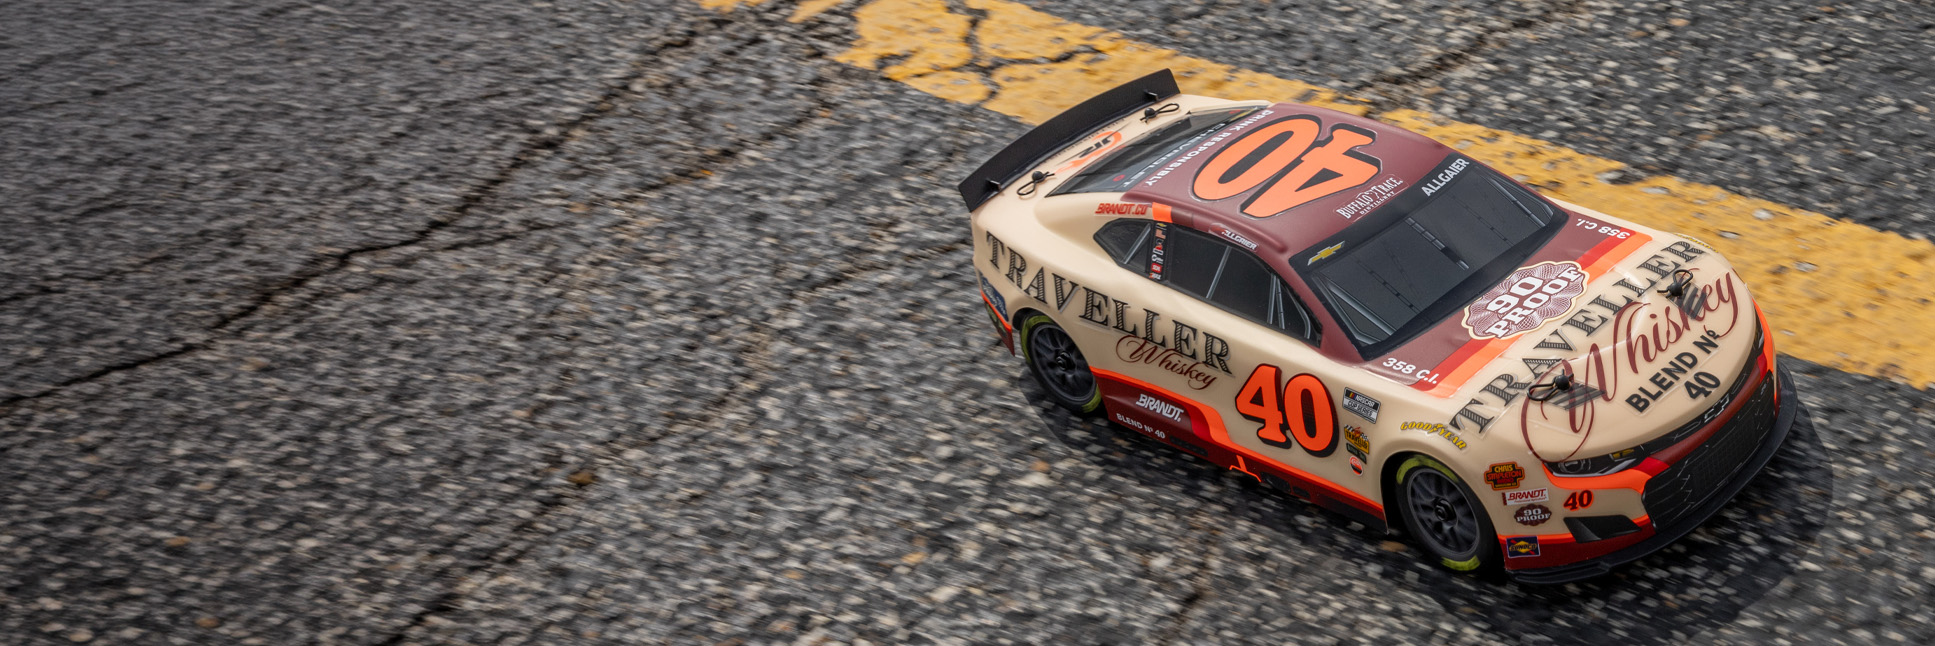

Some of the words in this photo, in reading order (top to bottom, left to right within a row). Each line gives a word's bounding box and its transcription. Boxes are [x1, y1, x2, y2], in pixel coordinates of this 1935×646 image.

[1235, 109, 1274, 132] DRINK
[1145, 132, 1231, 186] RESPONSIBLY
[1192, 114, 1382, 218] 40
[1421, 158, 1470, 197] ALLGAIER
[1336, 192, 1374, 219] BUFFALO
[1359, 191, 1395, 215] DISTILLERY
[1598, 226, 1631, 239] 358
[985, 231, 1232, 375] TRAVELLER
[1485, 266, 1583, 340] PROOF
[1486, 275, 1546, 316] 90
[1448, 240, 1706, 433] TRAVELLER
[1115, 335, 1218, 391] Whiskey
[1383, 357, 1416, 375] 358
[1415, 369, 1440, 385] C.I.
[1521, 267, 1738, 463] Whiskey
[1625, 350, 1699, 413] BLEND
[1684, 371, 1721, 399] 40
[1235, 363, 1339, 458] 40
[1355, 395, 1375, 408] NASCAR
[1116, 413, 1142, 430] BLEND
[1154, 429, 1166, 439] 40
[1400, 421, 1467, 451] GOODYEAR
[1494, 464, 1513, 473] CHRIS
[1523, 508, 1542, 516] 90
[1563, 490, 1595, 511] 40
[1516, 512, 1551, 522] PROOF
